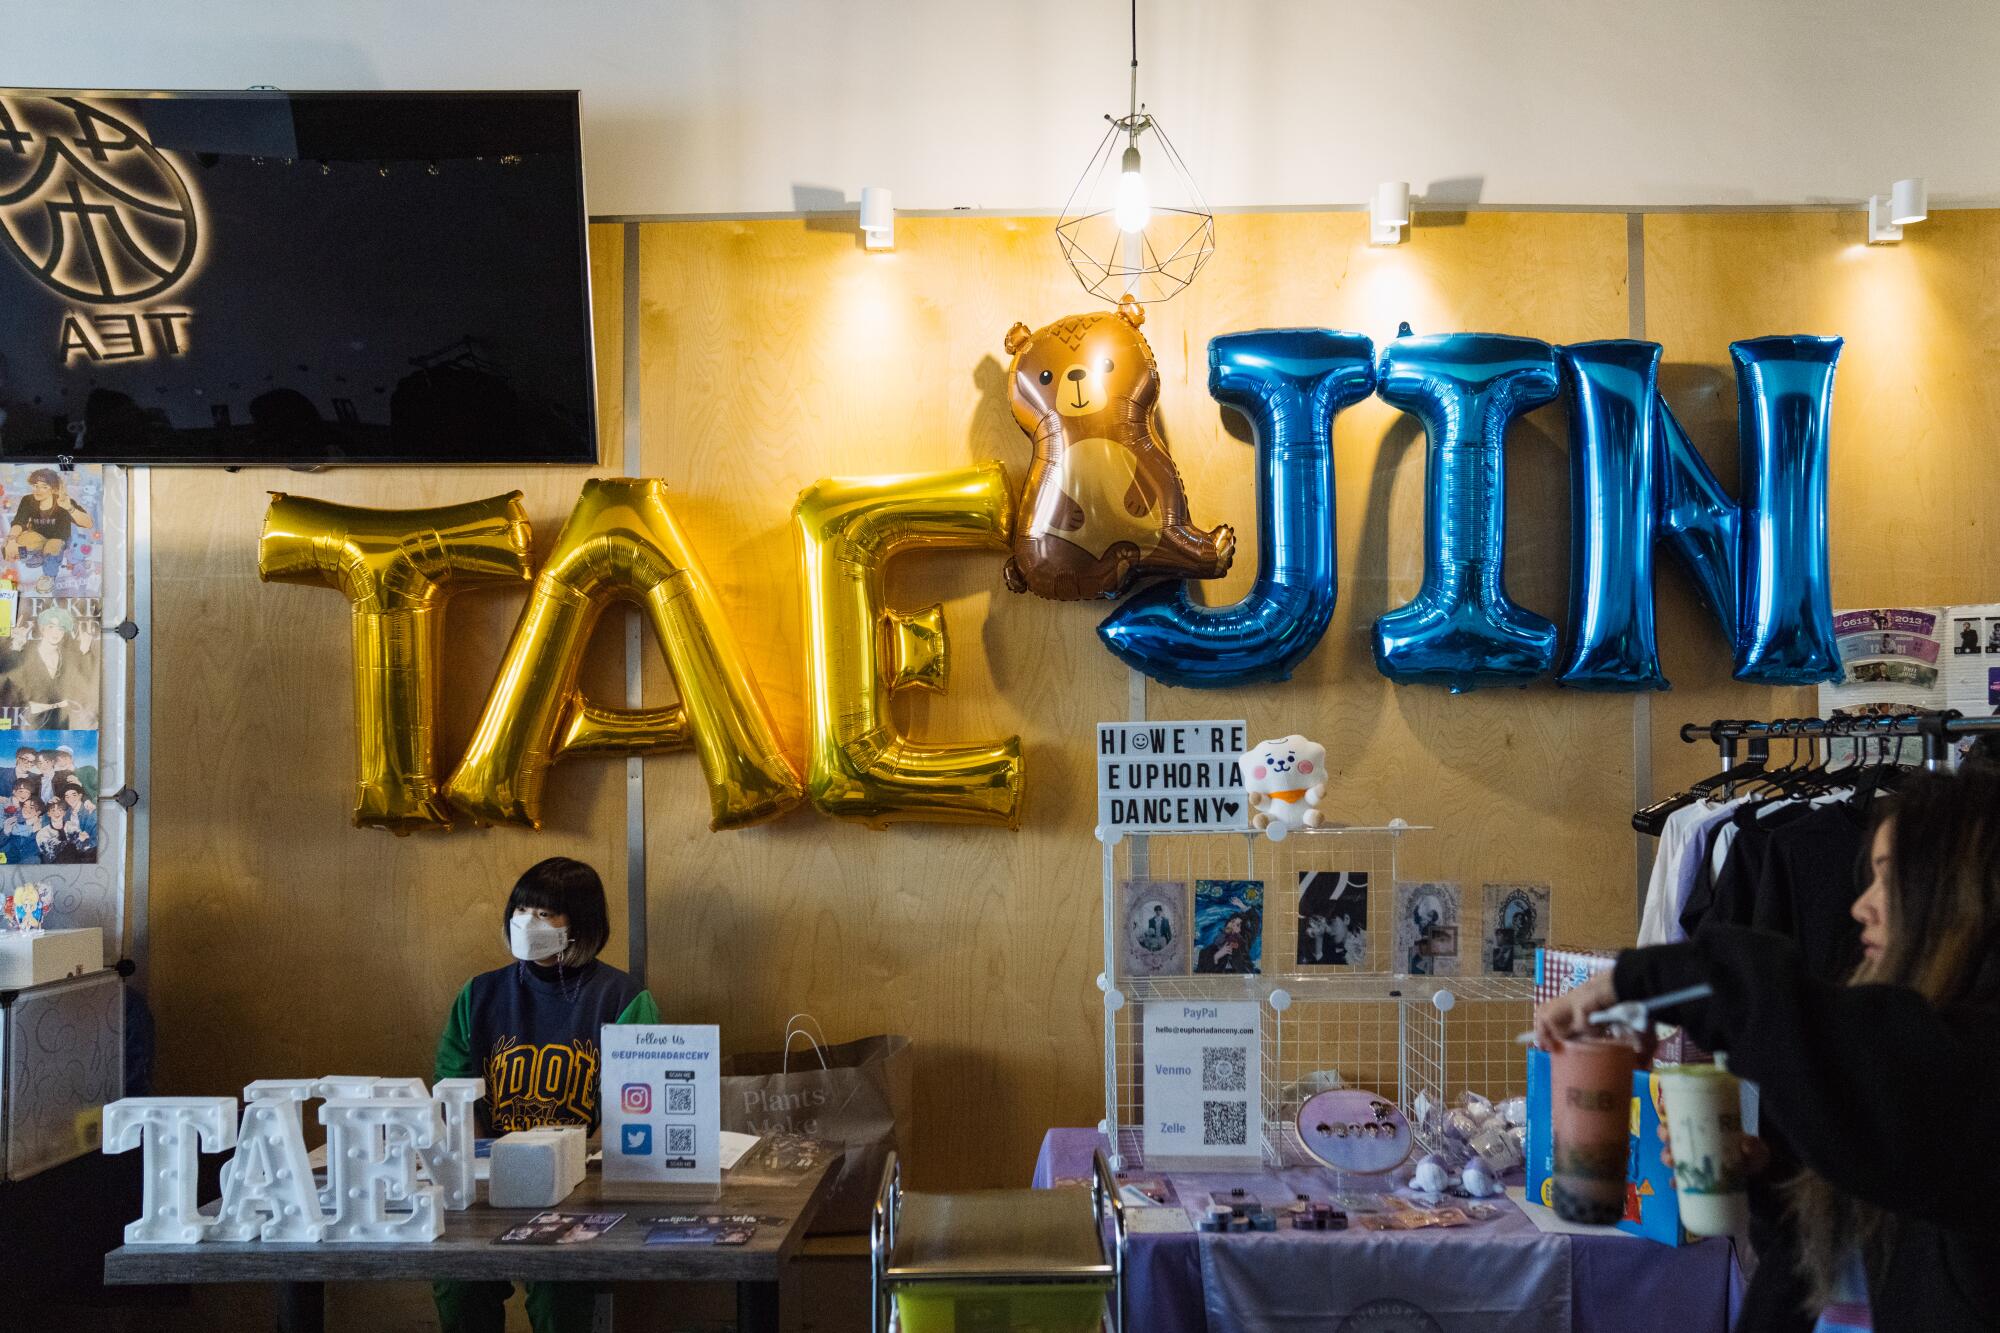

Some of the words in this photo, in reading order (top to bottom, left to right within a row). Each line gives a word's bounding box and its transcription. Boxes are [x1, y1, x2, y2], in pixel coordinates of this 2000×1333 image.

[257, 463, 1024, 835] TAE
[1096, 326, 1845, 692] JIN
[1894, 615, 1923, 625] 2013
[22, 620, 101, 641] LVE
[1101, 729, 1126, 754] HI
[1108, 761, 1243, 789] EUPHORIA
[1111, 798, 1226, 824] DANCENY
[1183, 1007, 1218, 1019] PayPal
[1155, 1026, 1254, 1036] hello@euphoriadanceny.com
[635, 1033, 668, 1046] Follow
[671, 1034, 685, 1046] Us
[611, 1051, 709, 1060] @EUPHORIADANCENY
[1155, 1064, 1191, 1076] Venmo
[742, 1087, 826, 1114] Plants
[1160, 1122, 1186, 1134] Zelle
